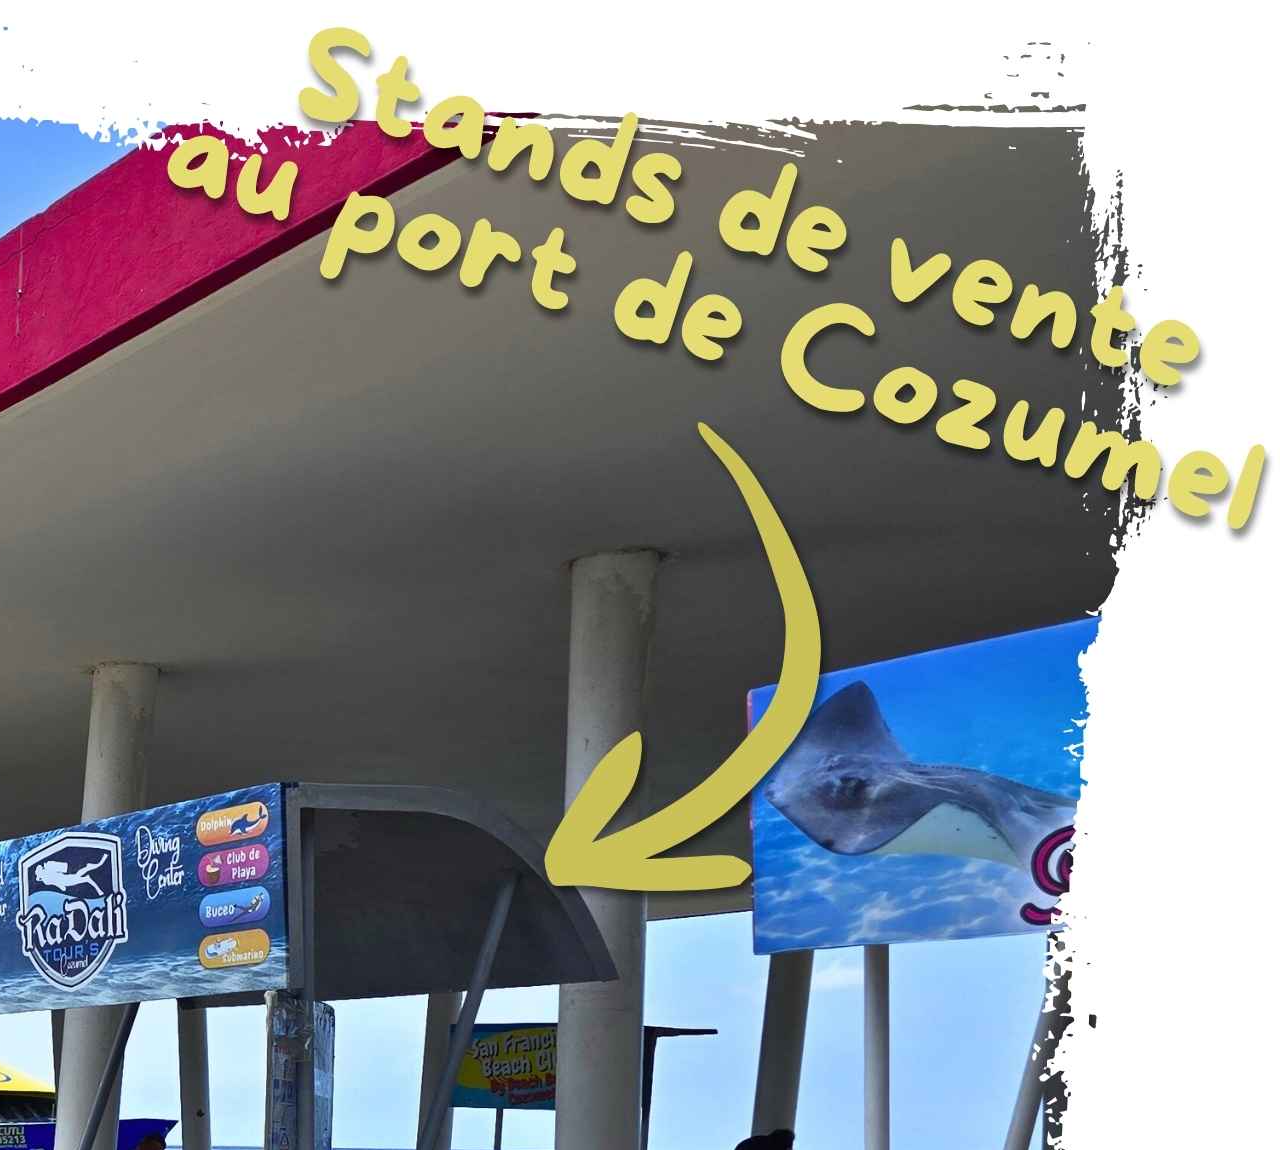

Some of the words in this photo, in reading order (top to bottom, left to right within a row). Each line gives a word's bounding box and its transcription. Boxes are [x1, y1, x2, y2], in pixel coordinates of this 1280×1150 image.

[201, 817, 232, 832] Dolphin
[136, 825, 181, 869] Diving
[227, 851, 246, 864] Club
[249, 848, 261, 860] de
[141, 864, 185, 899] Center
[231, 866, 256, 880] Playa
[206, 904, 235, 918] Buceo
[43, 941, 99, 959] TOUR'S
[472, 1038, 499, 1059] San
[482, 1058, 532, 1077] Beach
